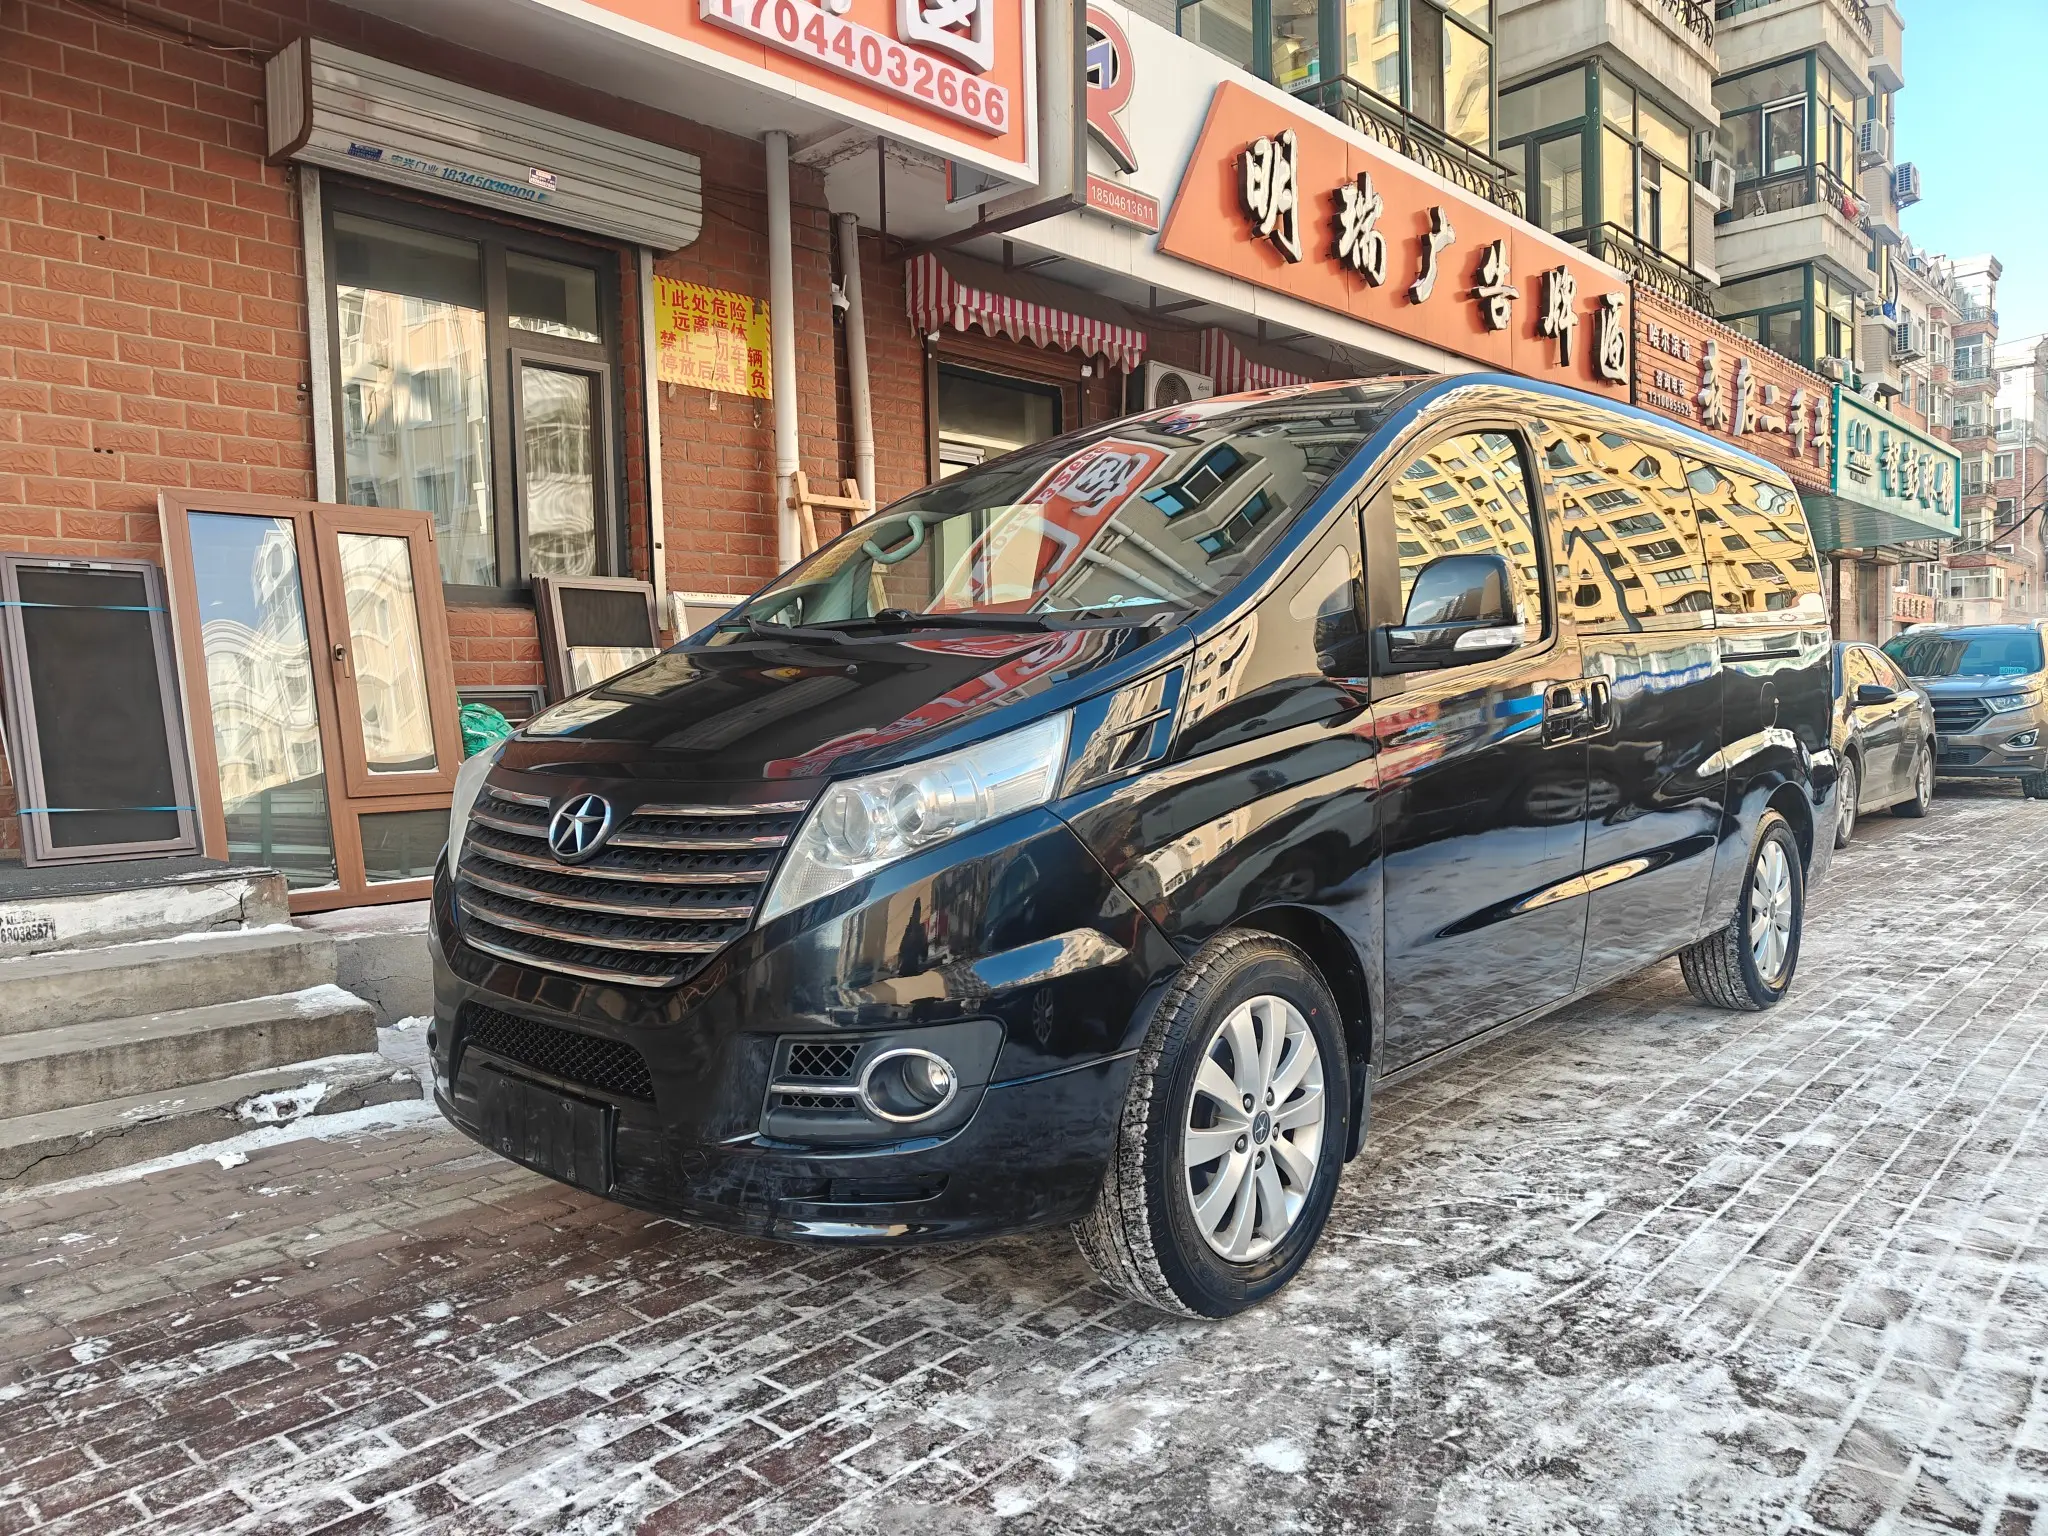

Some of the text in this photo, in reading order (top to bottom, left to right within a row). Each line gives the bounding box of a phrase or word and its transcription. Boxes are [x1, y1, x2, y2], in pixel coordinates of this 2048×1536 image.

[1091, 184, 1154, 221] 18504613611
[671, 309, 748, 342] 远离墙体
[1648, 321, 1691, 361] 哈尔滨市
[660, 329, 763, 369] 禁止一切车辆
[660, 352, 766, 391] 停放后果自负
